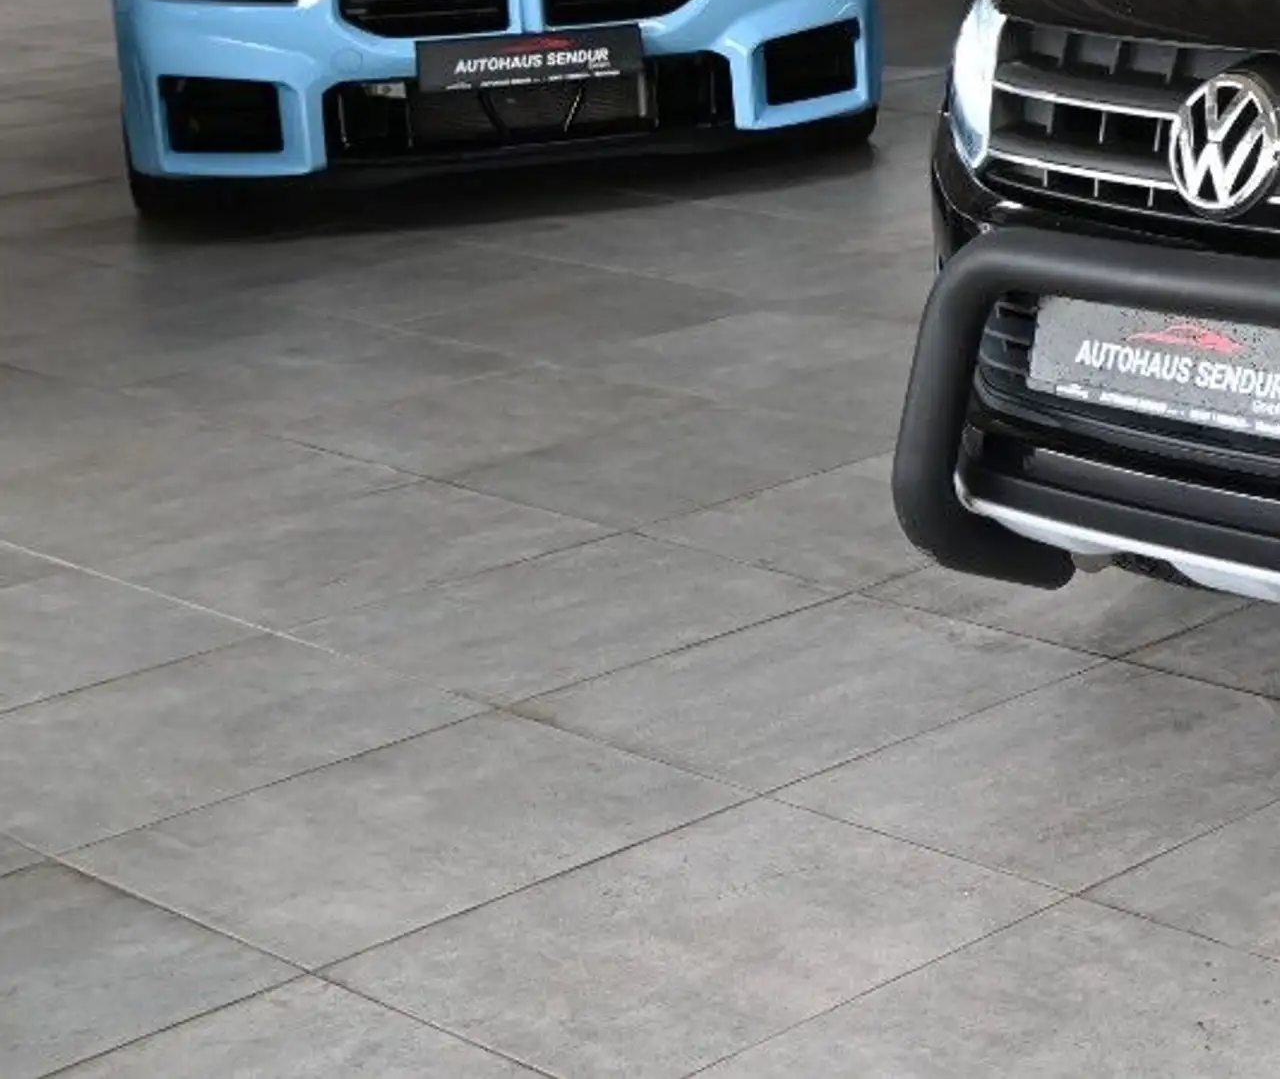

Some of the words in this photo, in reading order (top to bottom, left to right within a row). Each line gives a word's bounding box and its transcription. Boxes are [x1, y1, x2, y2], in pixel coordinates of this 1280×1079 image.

[454, 53, 543, 75] AUTOHAUS
[546, 47, 610, 67] SENDUR
[1074, 340, 1194, 385] AUTOHAUS
